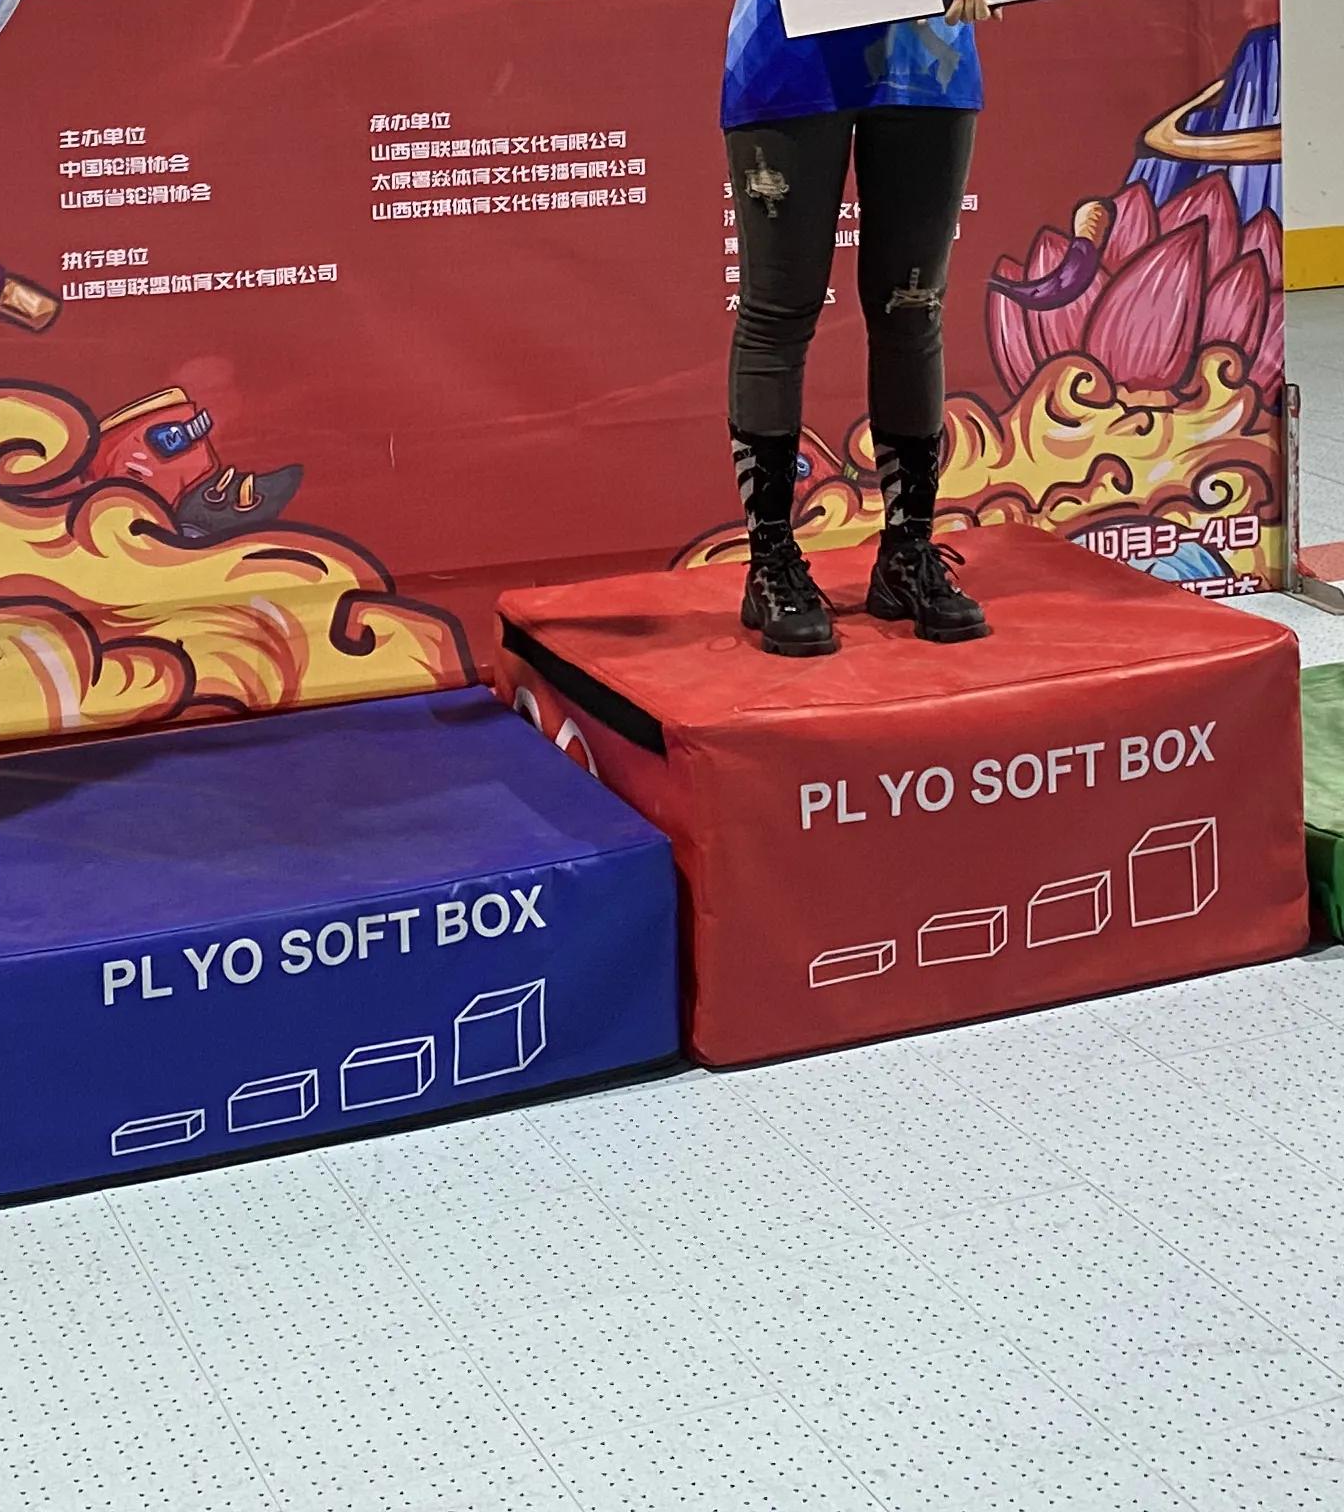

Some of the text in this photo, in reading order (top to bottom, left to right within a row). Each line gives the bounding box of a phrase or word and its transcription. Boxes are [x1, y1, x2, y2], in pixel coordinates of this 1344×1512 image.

[370, 112, 451, 133] 承办单位
[59, 127, 146, 149] 主办单位
[59, 154, 190, 178] 中国轮滑协会
[60, 183, 212, 209] 山西省轮滑协会
[61, 248, 149, 271] 执行单位
[970, 741, 1106, 804] SOFT
[1119, 720, 1217, 781] BOX
[280, 908, 420, 974] SOFT
[435, 884, 547, 948] BOX
